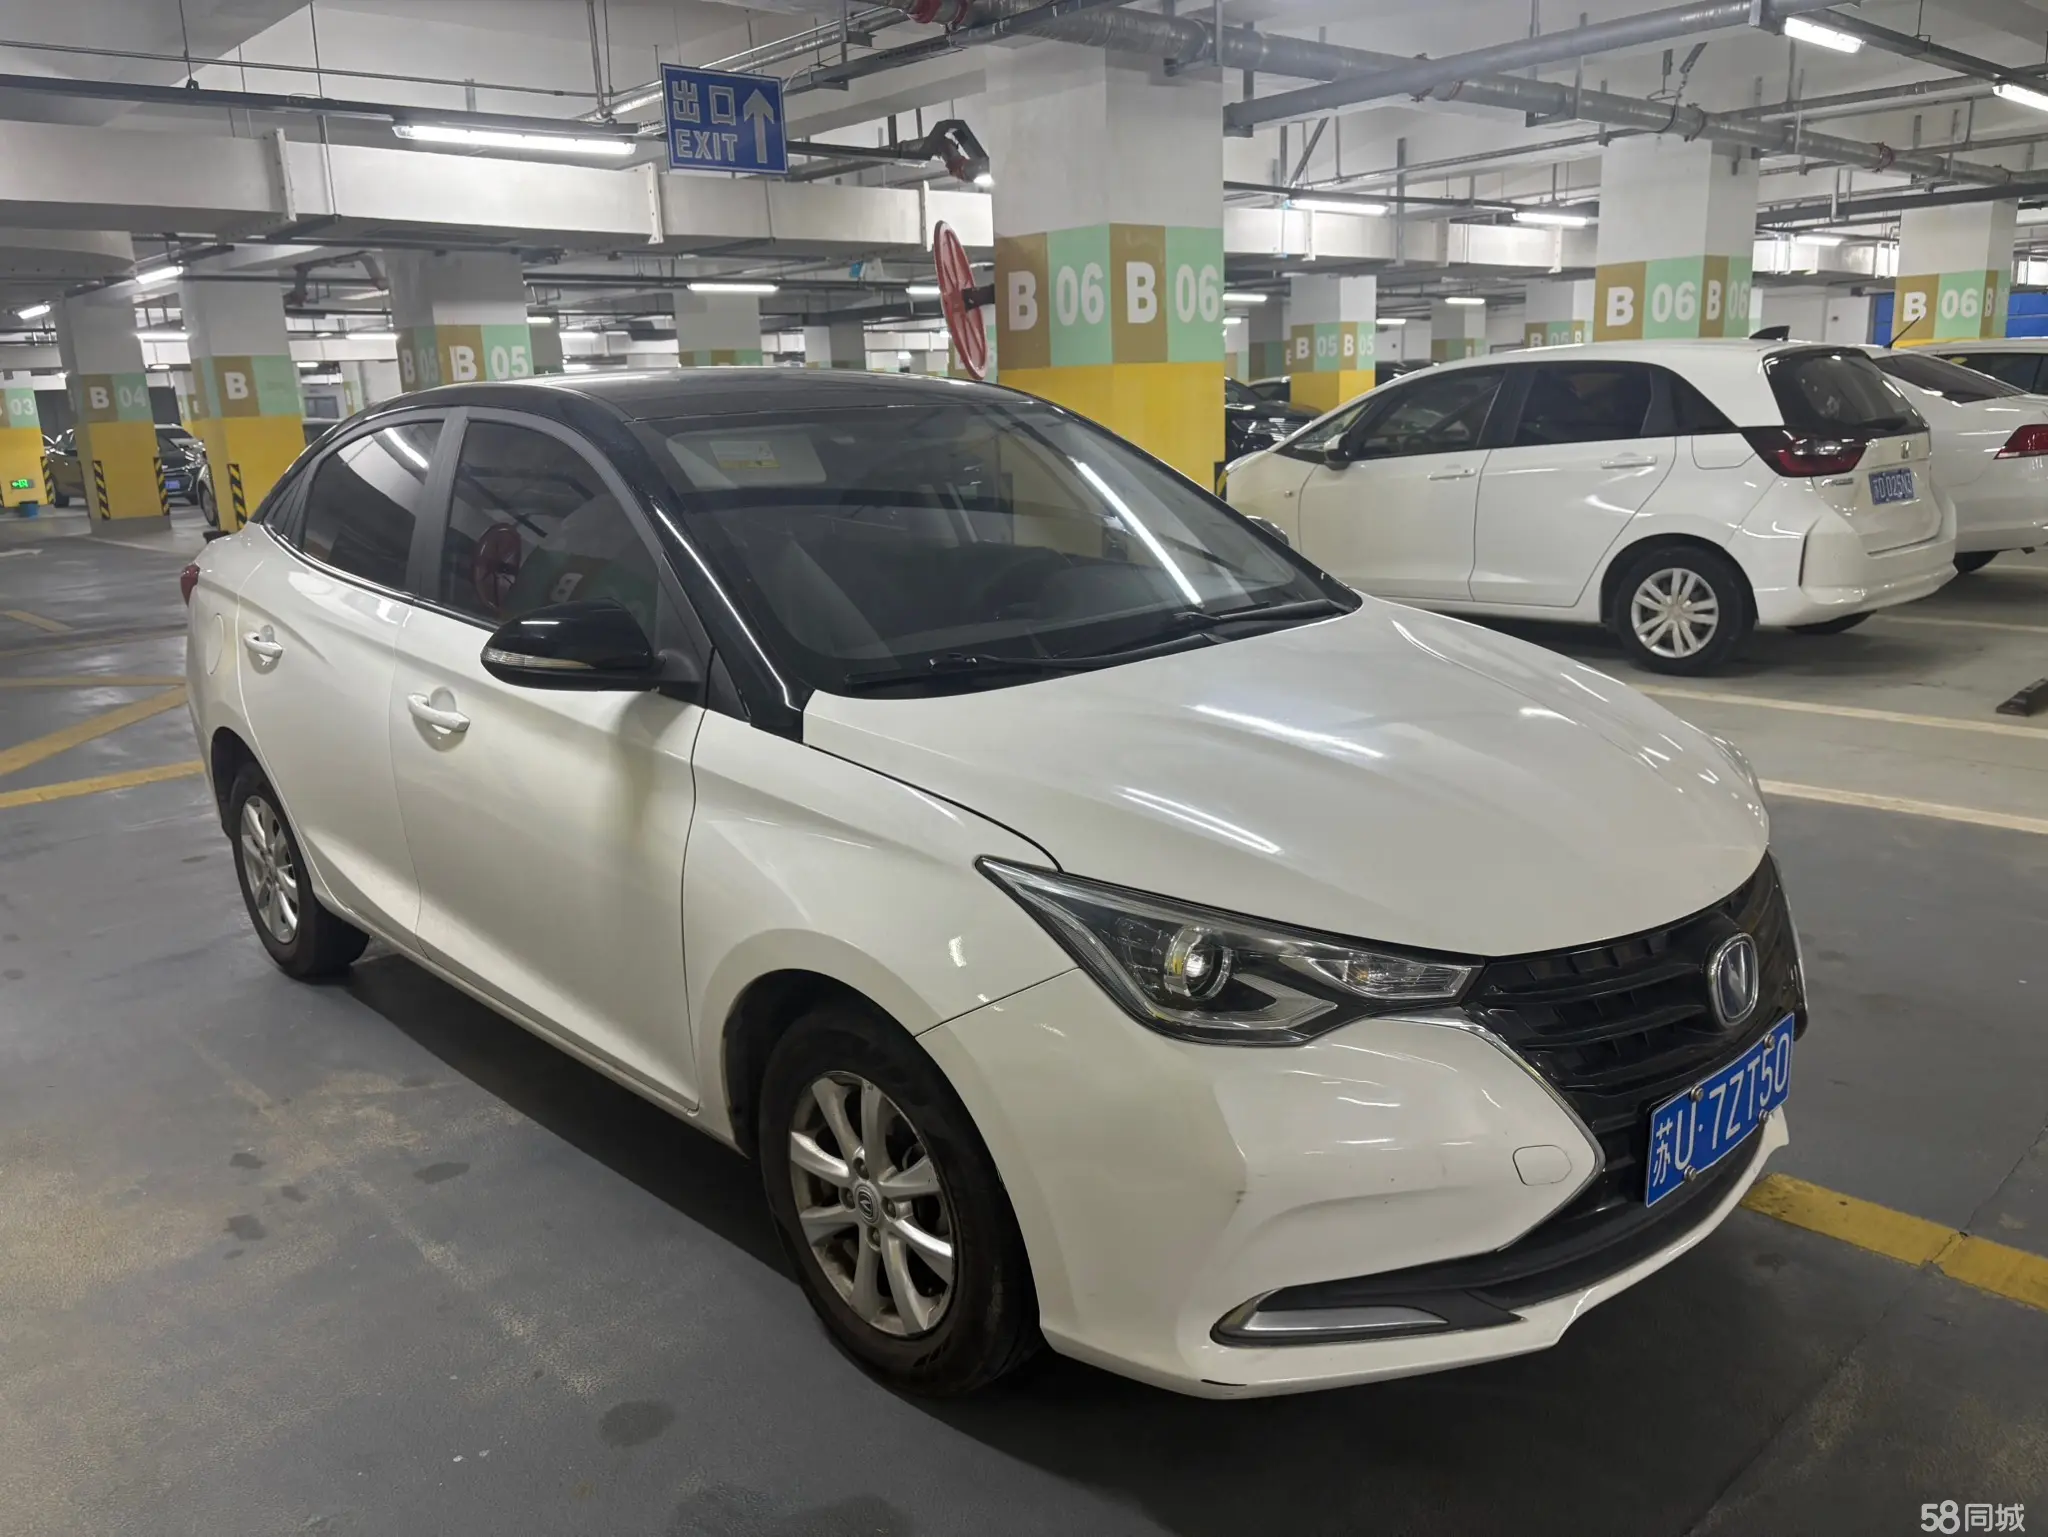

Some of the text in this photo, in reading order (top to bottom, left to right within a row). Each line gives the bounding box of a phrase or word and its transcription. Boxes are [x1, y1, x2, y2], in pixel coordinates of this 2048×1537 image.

[672, 80, 736, 126] 出口
[675, 129, 738, 161] EXIT
[1008, 262, 1104, 331] B 06
[1126, 261, 1219, 324] B 06
[1606, 281, 1696, 327] B 06
[1706, 280, 1750, 320] B 06
[1903, 291, 1927, 322] B
[1941, 288, 1979, 319] 06
[1296, 337, 1310, 360] B
[1316, 334, 1338, 357] 05
[1344, 333, 1374, 356] B 05
[402, 349, 415, 383] B
[449, 345, 529, 381] B 05
[89, 386, 109, 409] B
[119, 385, 147, 408] 04
[224, 372, 248, 399] B
[11, 398, 34, 416] 03
